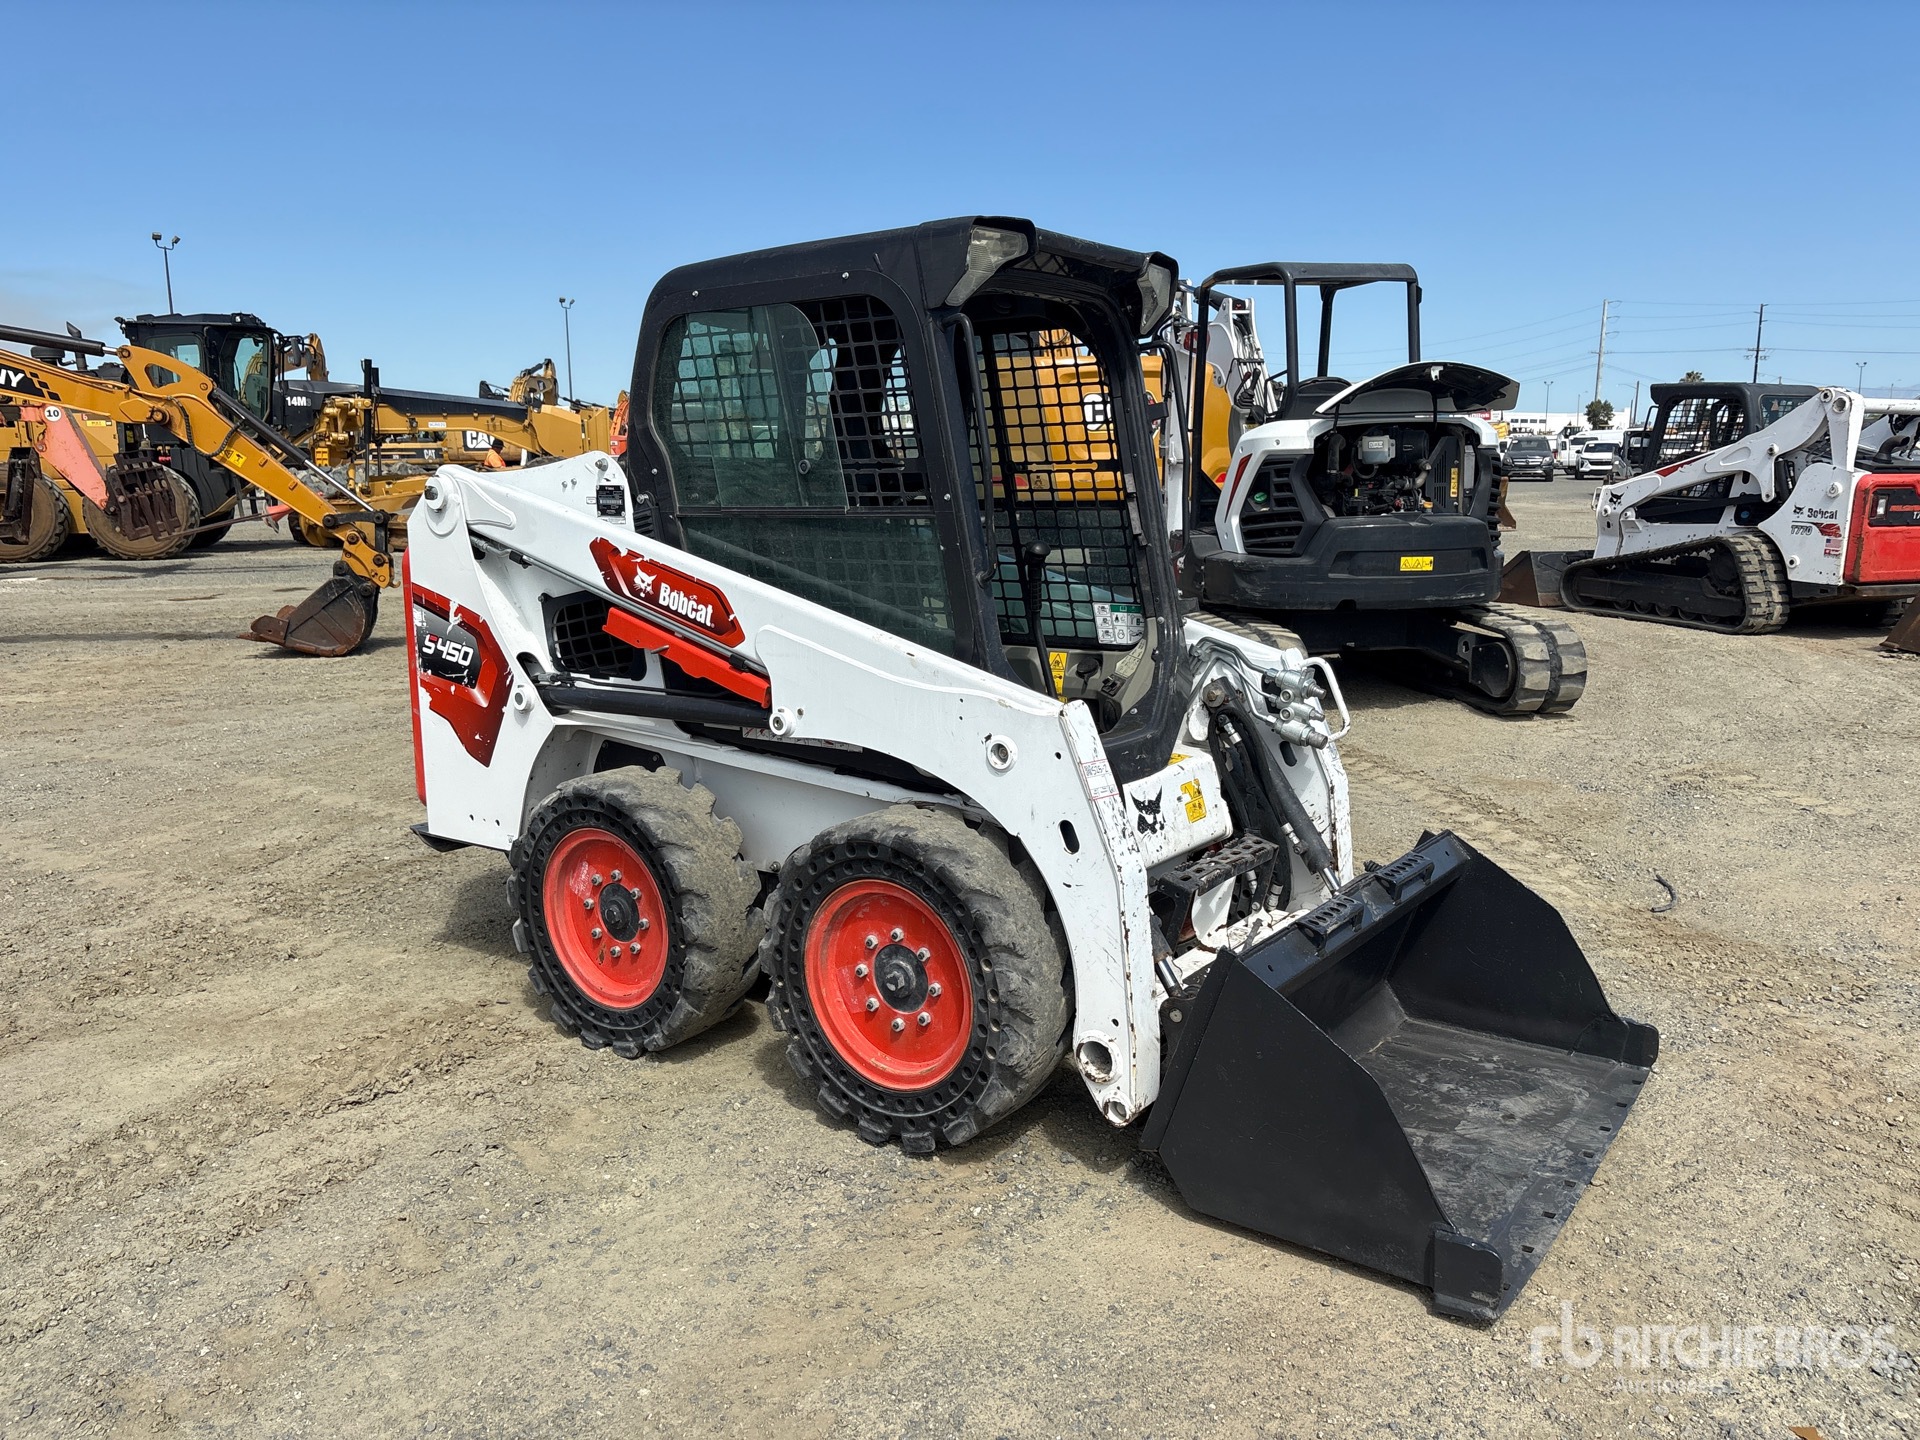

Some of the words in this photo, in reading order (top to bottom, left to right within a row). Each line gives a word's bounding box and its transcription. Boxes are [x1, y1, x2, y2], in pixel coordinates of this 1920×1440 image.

[46, 409, 60, 418] 10
[423, 449, 436, 460] CAT
[1790, 524, 1813, 536] T770
[658, 582, 714, 627] Bobcat
[422, 634, 474, 667] S450
